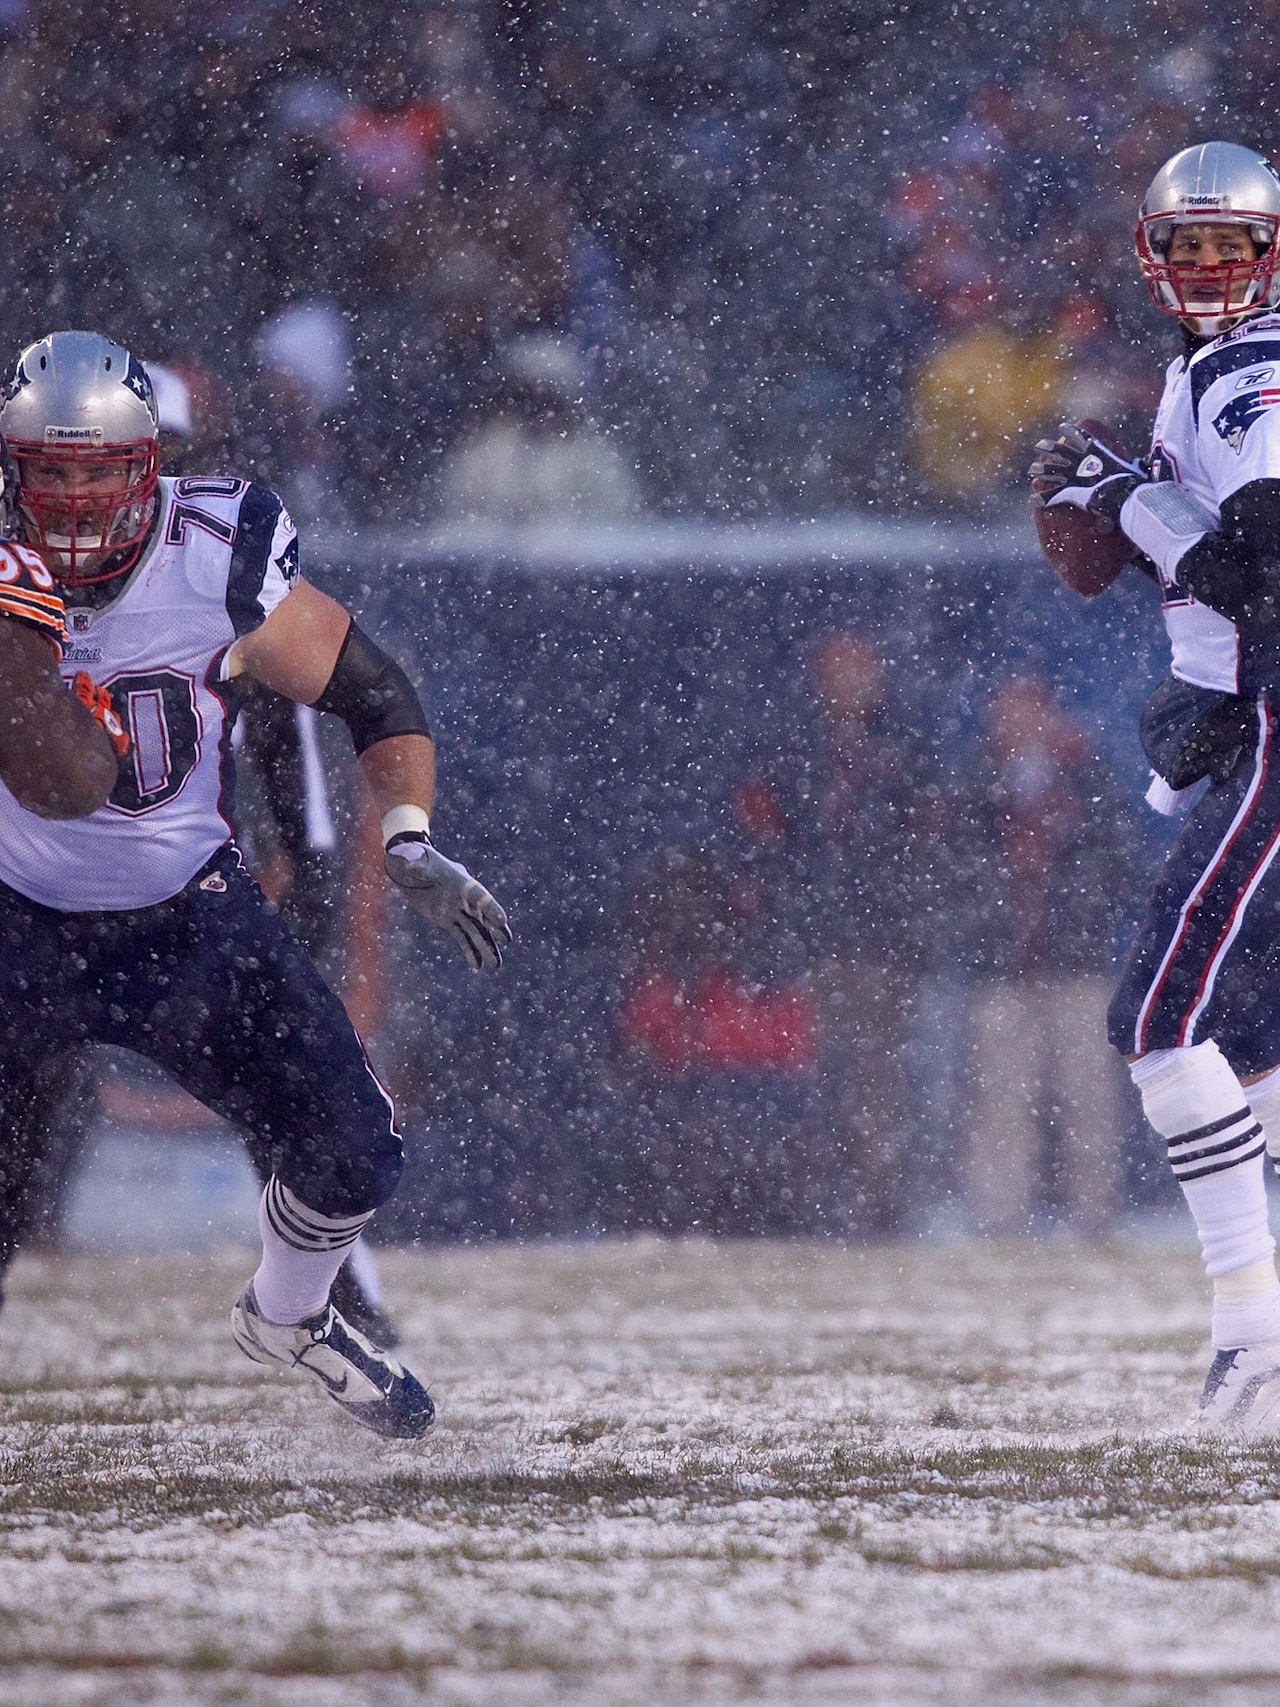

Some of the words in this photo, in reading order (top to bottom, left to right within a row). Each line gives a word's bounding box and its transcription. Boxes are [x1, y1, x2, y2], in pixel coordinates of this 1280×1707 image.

[57, 430, 91, 439] Riddell
[165, 476, 247, 547] 70
[63, 642, 103, 663] atriots
[63, 665, 203, 818] 0
